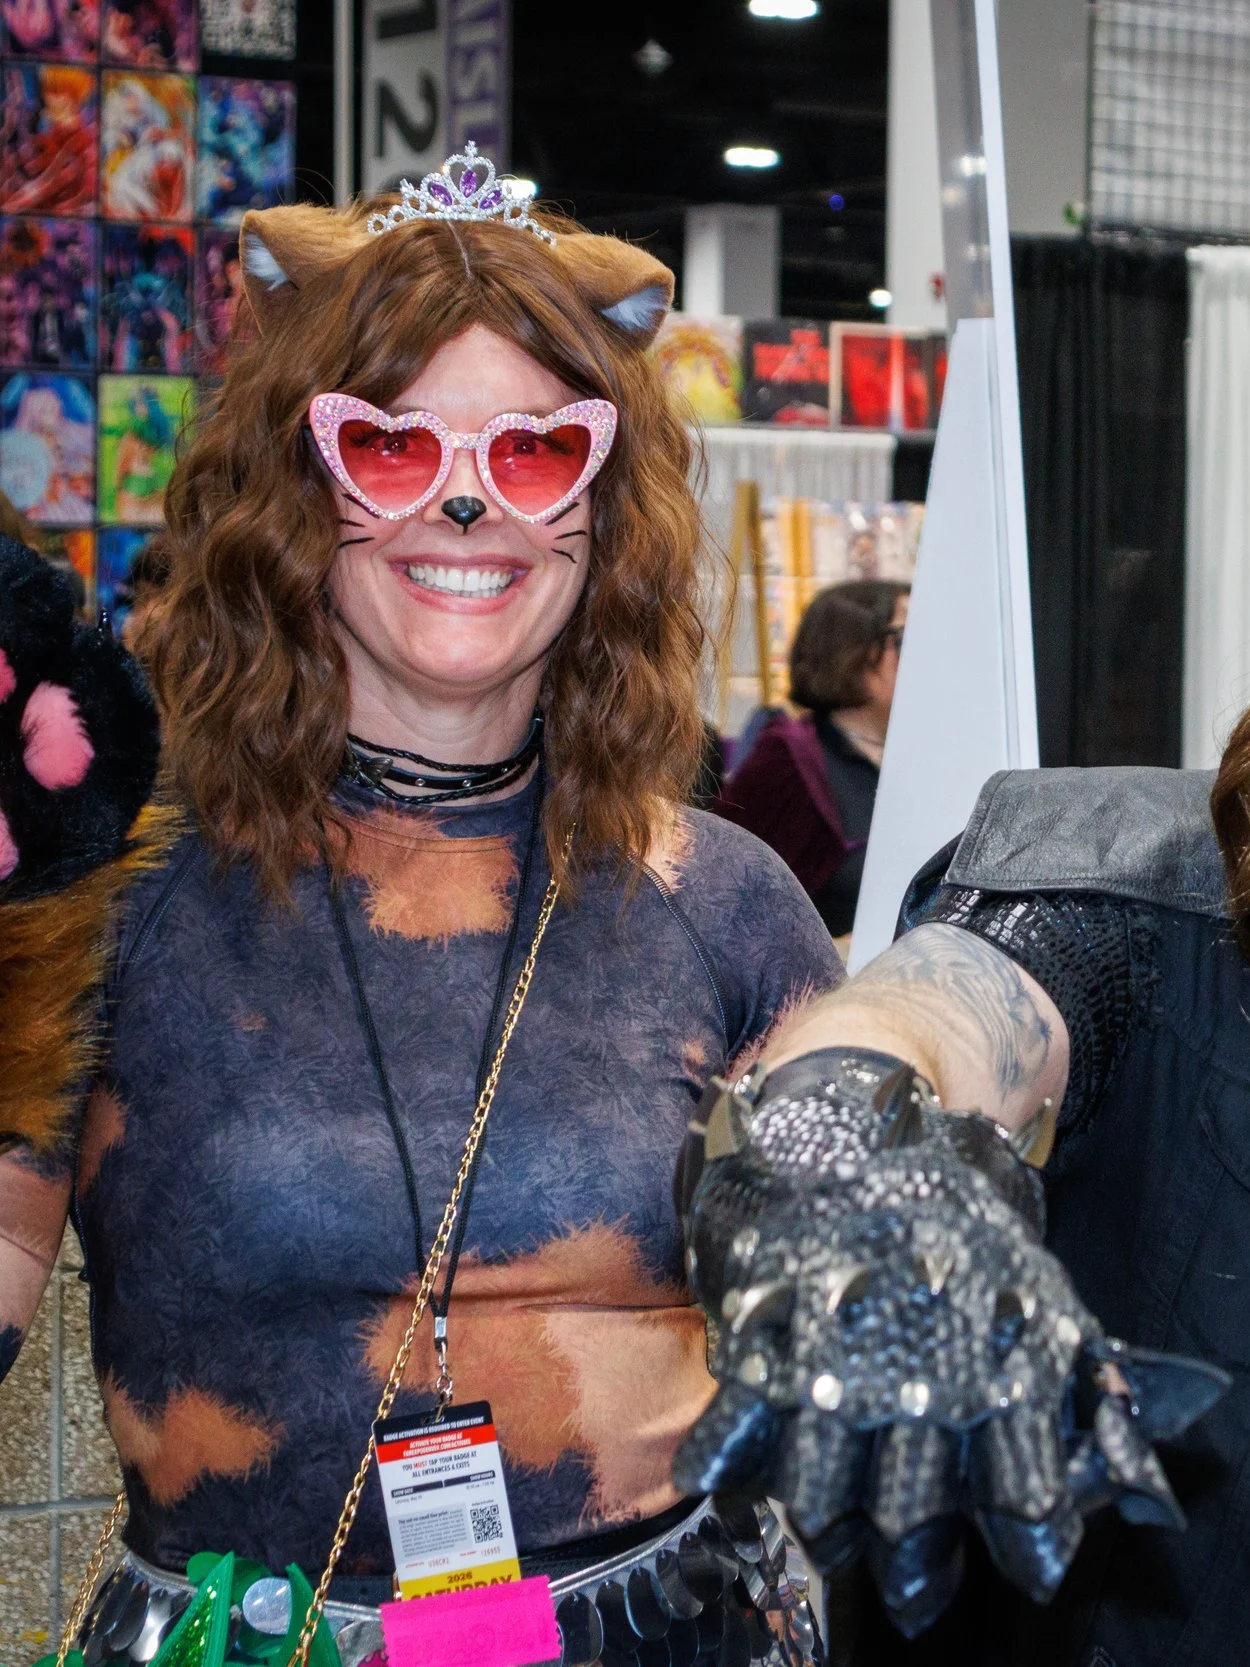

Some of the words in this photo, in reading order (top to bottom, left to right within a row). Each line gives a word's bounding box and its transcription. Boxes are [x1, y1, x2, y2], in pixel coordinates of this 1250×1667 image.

[375, 0, 439, 197] 12
[383, 1432, 399, 1442] BADGE
[398, 1427, 424, 1439] ACTIVATION
[423, 1426, 429, 1434] IS
[428, 1422, 450, 1433] REQUIRED
[450, 1421, 456, 1429] TO
[456, 1418, 470, 1428] ENTER
[470, 1416, 484, 1425] EVENT
[453, 1452, 470, 1461] BADGE
[412, 1470, 421, 1478] ALL
[421, 1465, 451, 1476] ENTRANCES
[456, 1461, 470, 1469] EXITS
[447, 1571, 473, 1583] 2026
